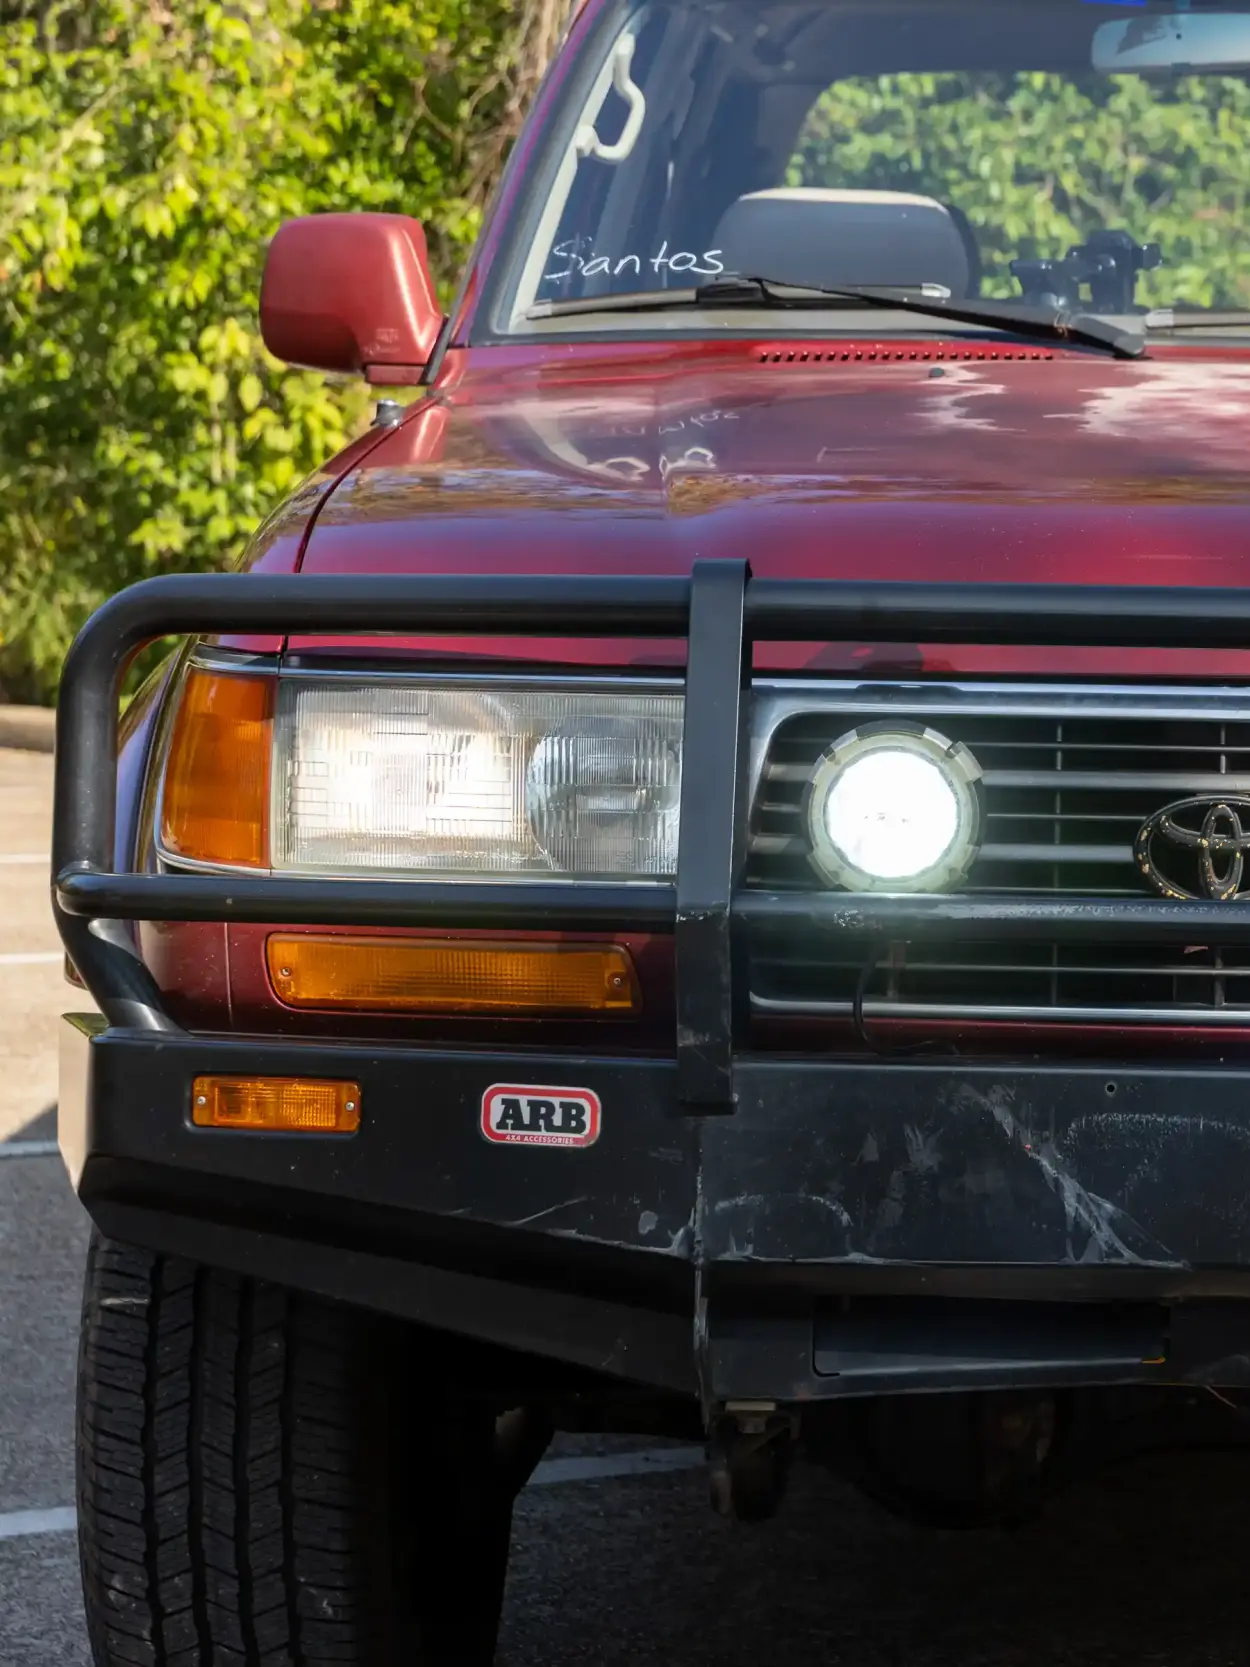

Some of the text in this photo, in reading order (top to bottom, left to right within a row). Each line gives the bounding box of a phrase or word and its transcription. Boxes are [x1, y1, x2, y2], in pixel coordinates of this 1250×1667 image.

[544, 236, 724, 284] Santos
[496, 1098, 587, 1134] ARB
[523, 1135, 574, 1145] ACCESSORIES
